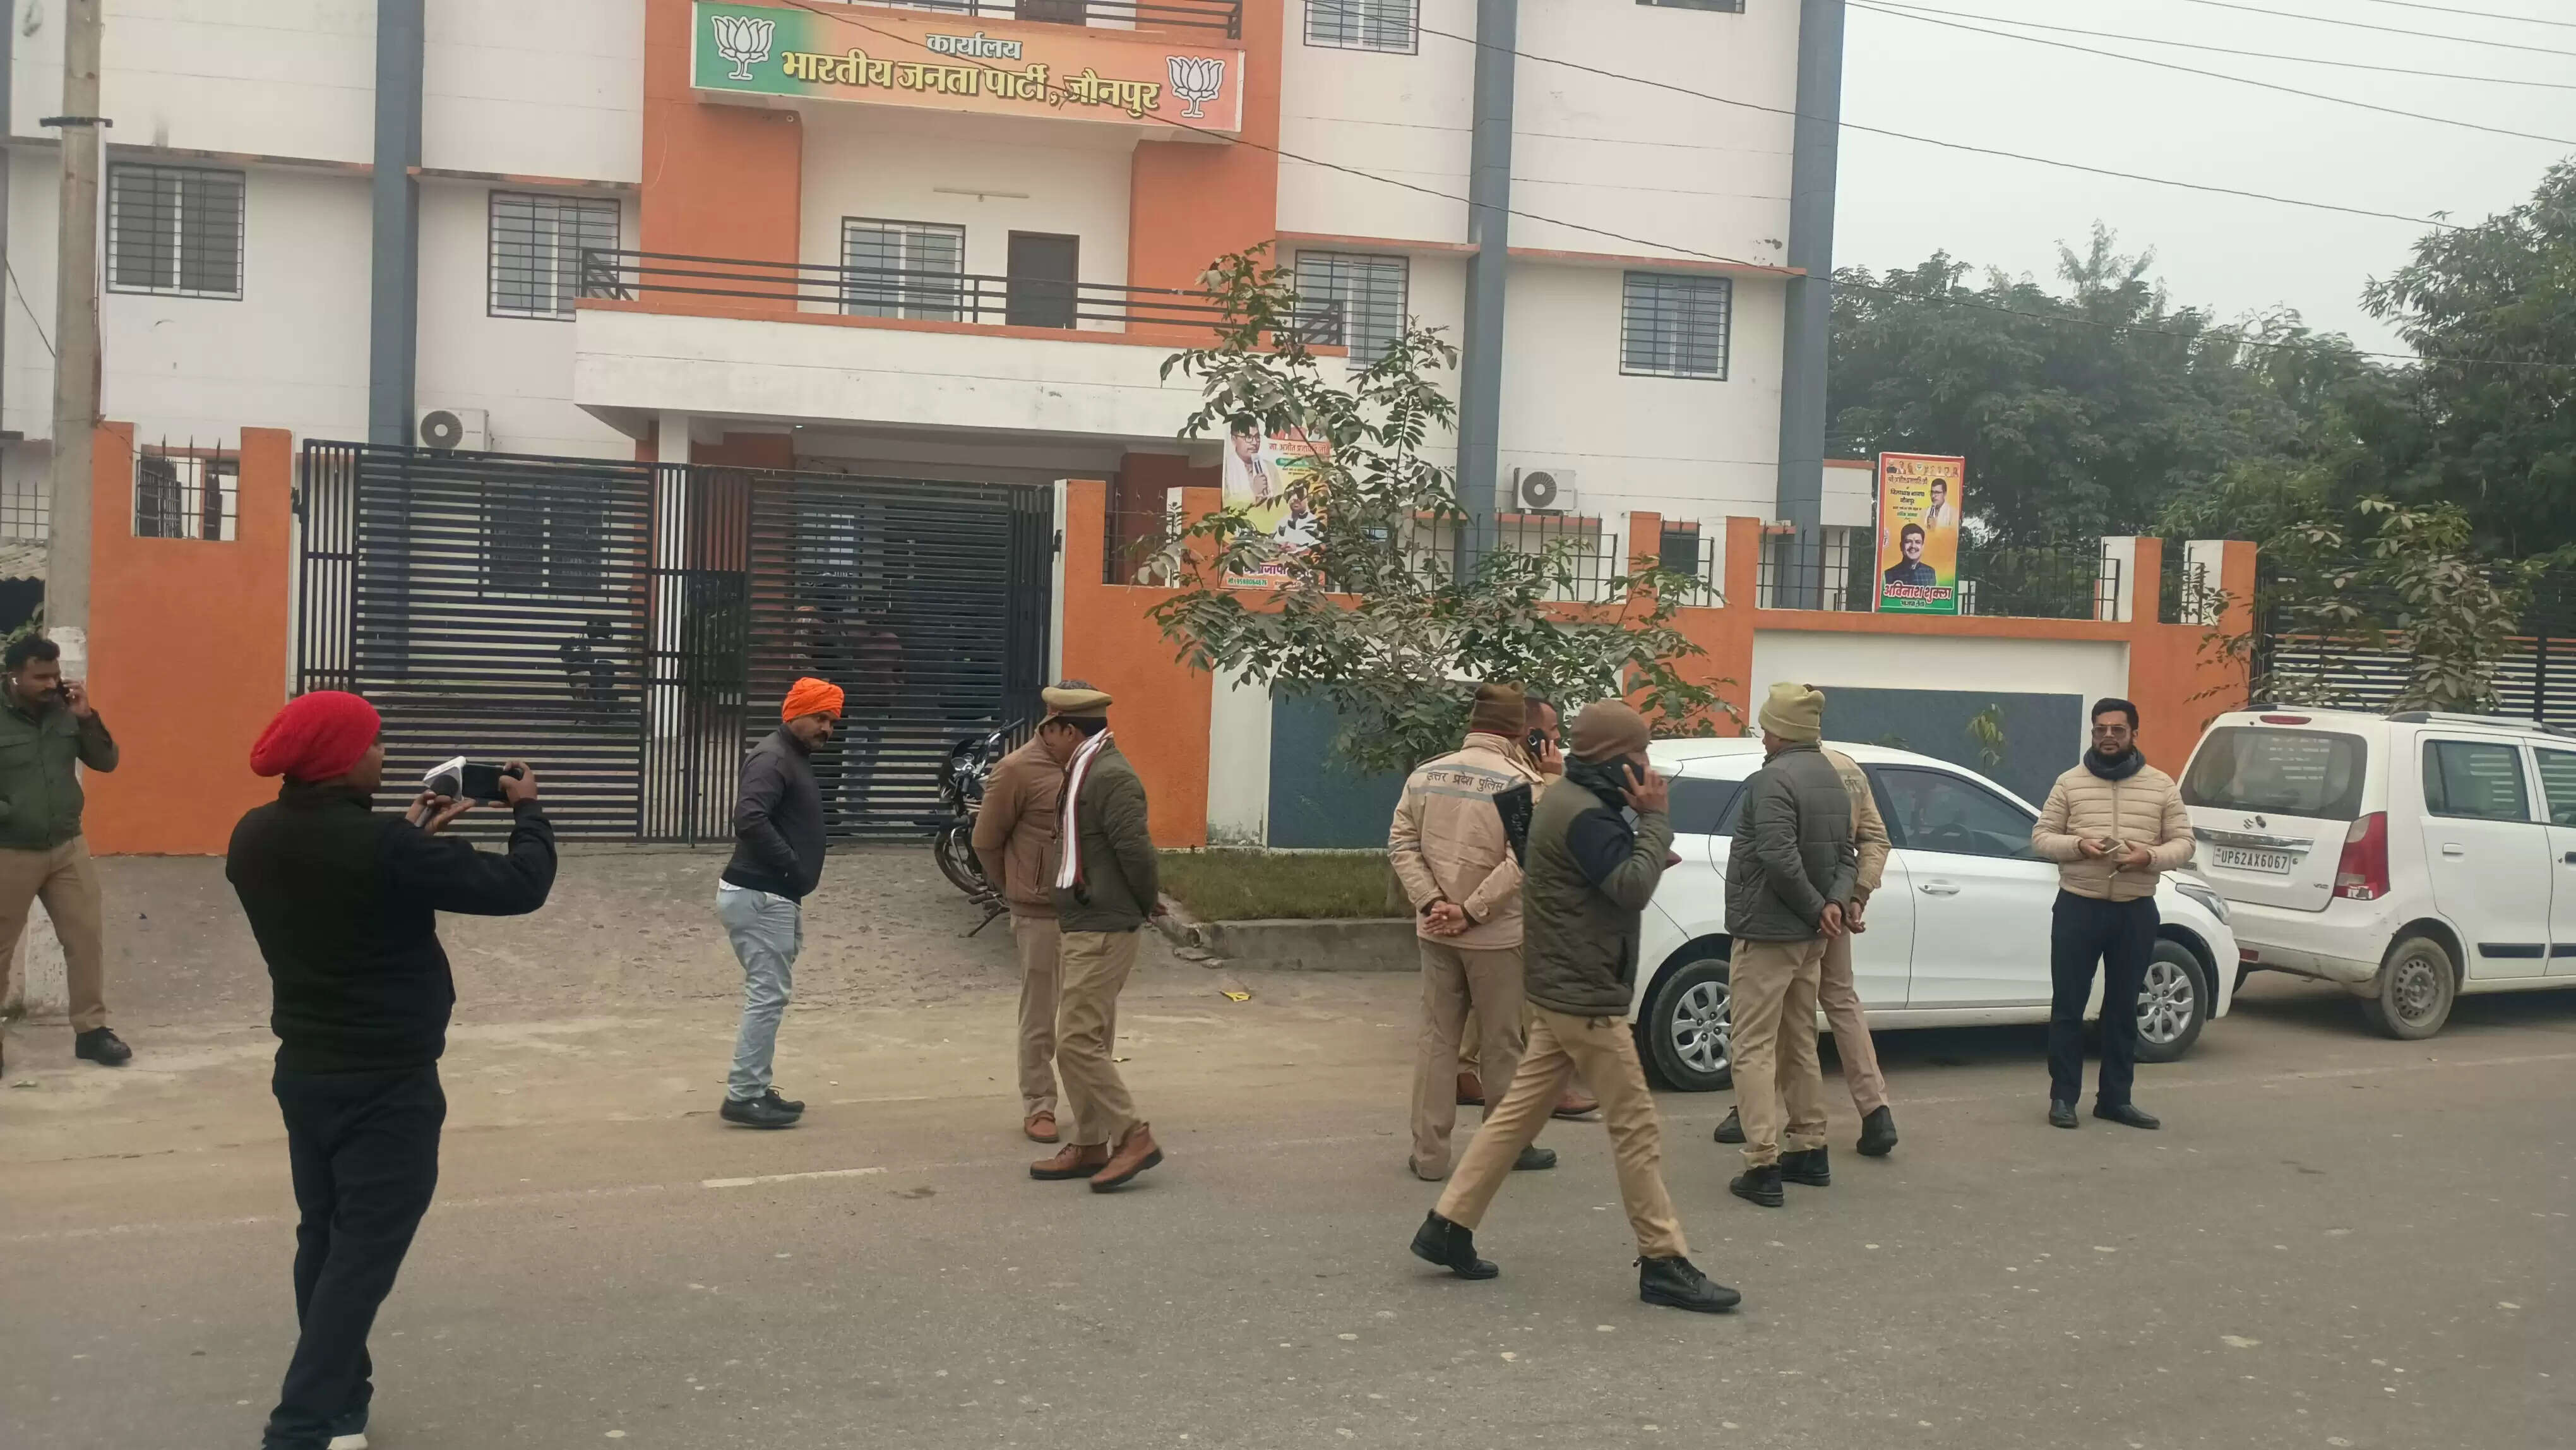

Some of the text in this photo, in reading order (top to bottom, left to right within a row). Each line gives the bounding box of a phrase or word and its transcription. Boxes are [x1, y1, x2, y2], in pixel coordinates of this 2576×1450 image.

[926, 32, 1023, 60] कार्यालय
[781, 47, 895, 88] भारतीय
[897, 61, 979, 94] जनता
[1063, 67, 1161, 119] जौनपुर
[1883, 580, 1953, 603] अविनाश शुक्ला
[1427, 770, 1505, 792] उत्तर प्रदेश पुलिस
[2221, 850, 2287, 870] UP62AX6067
